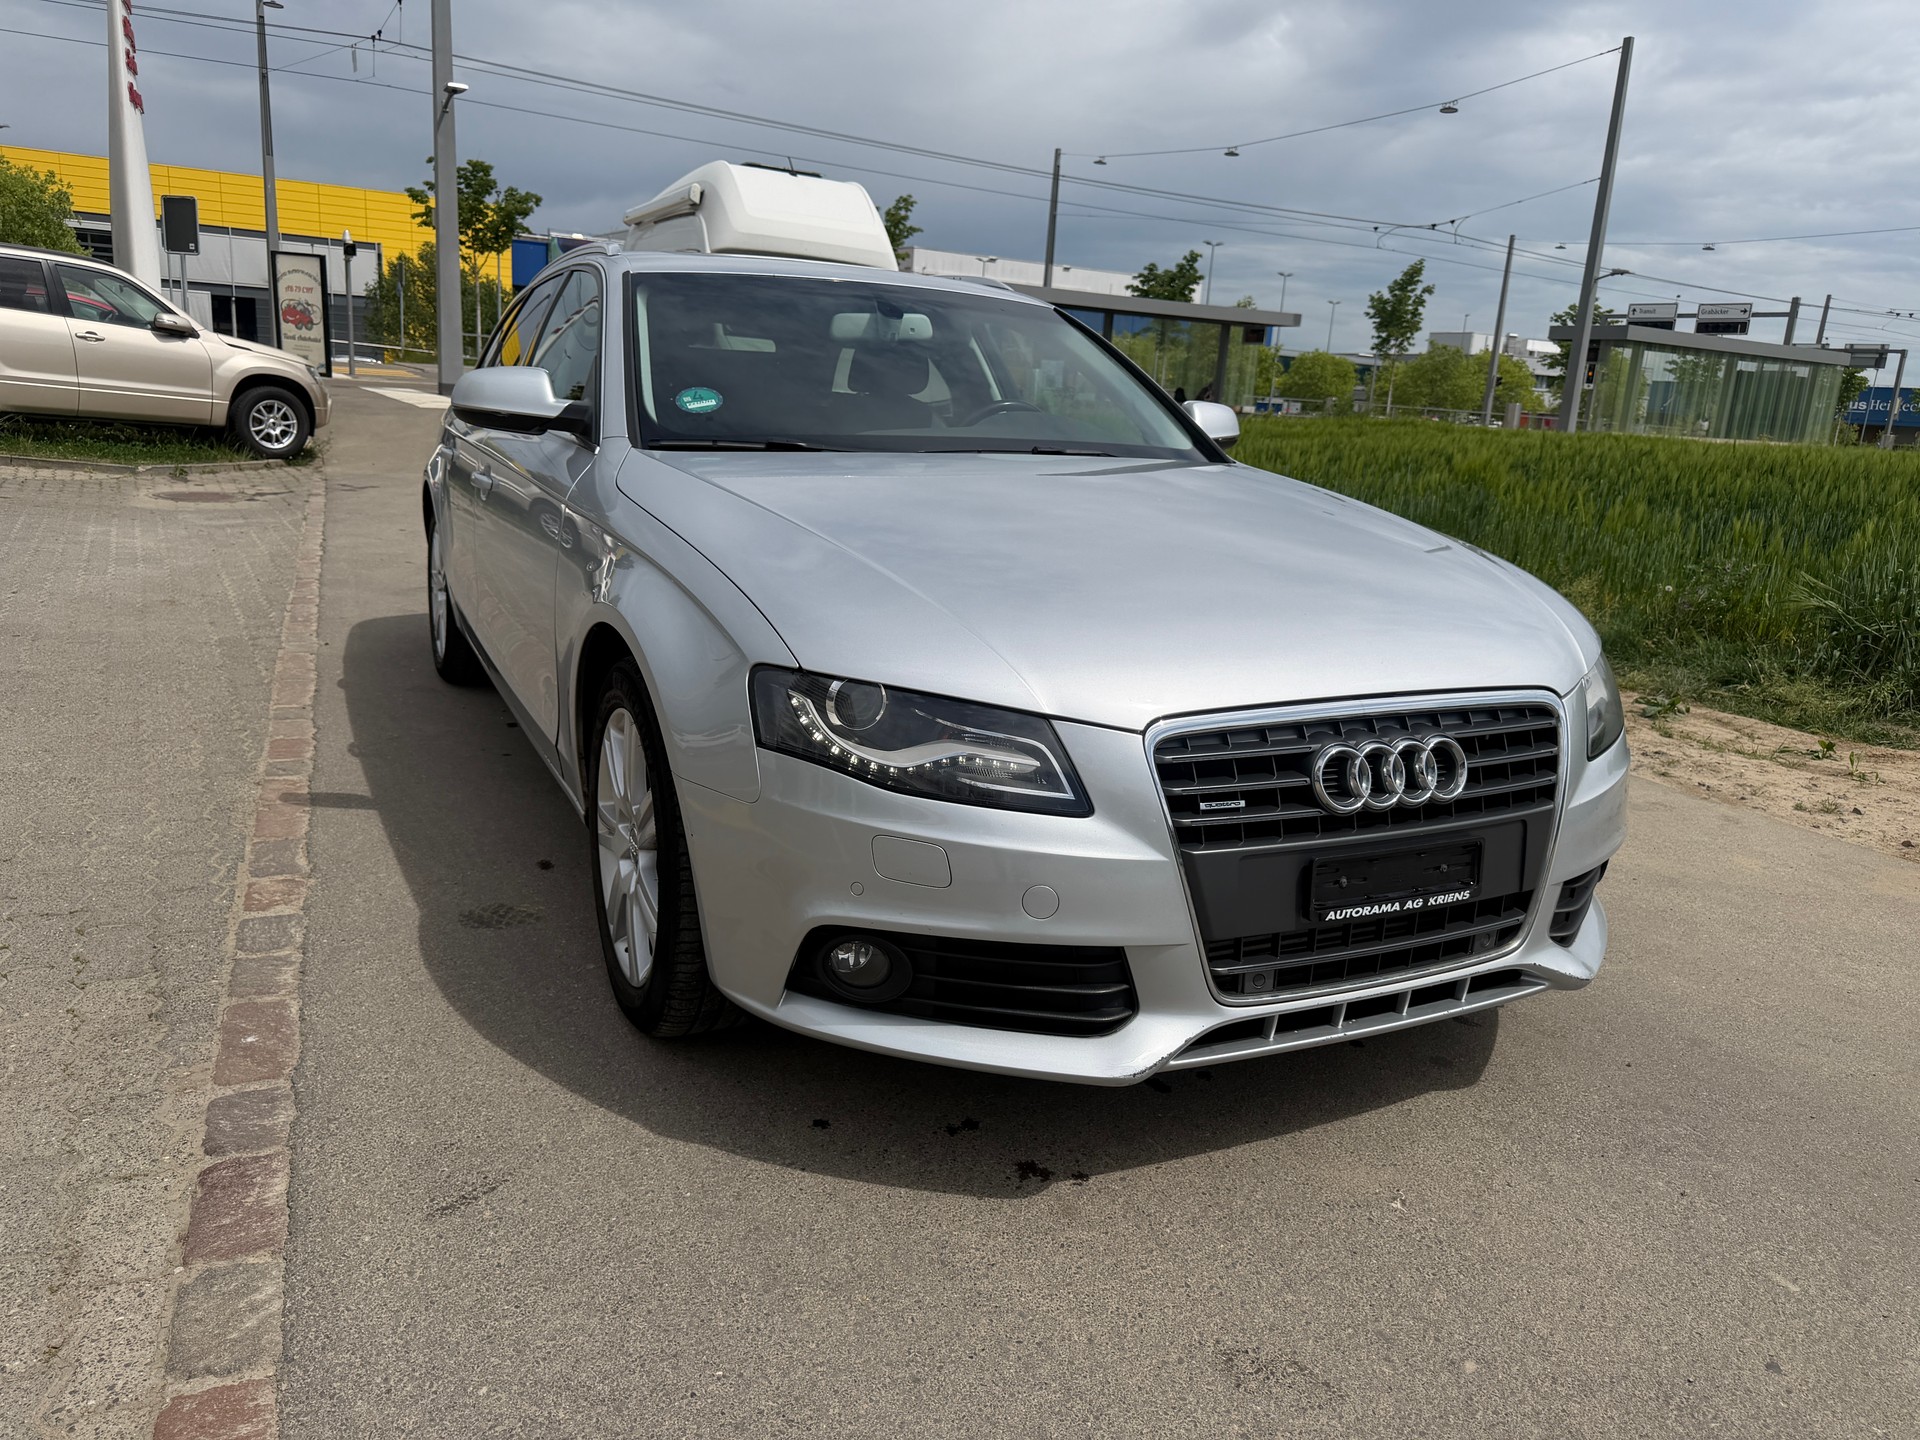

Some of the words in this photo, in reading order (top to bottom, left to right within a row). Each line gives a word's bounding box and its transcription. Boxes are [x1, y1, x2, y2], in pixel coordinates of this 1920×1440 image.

[1700, 308, 1729, 316] Grabäcker
[1847, 401, 1867, 410] us
[1204, 801, 1241, 809] quattro
[1325, 902, 1400, 921] AUTORAMA
[1403, 898, 1423, 910] AG
[1428, 890, 1470, 906] KRIENS
